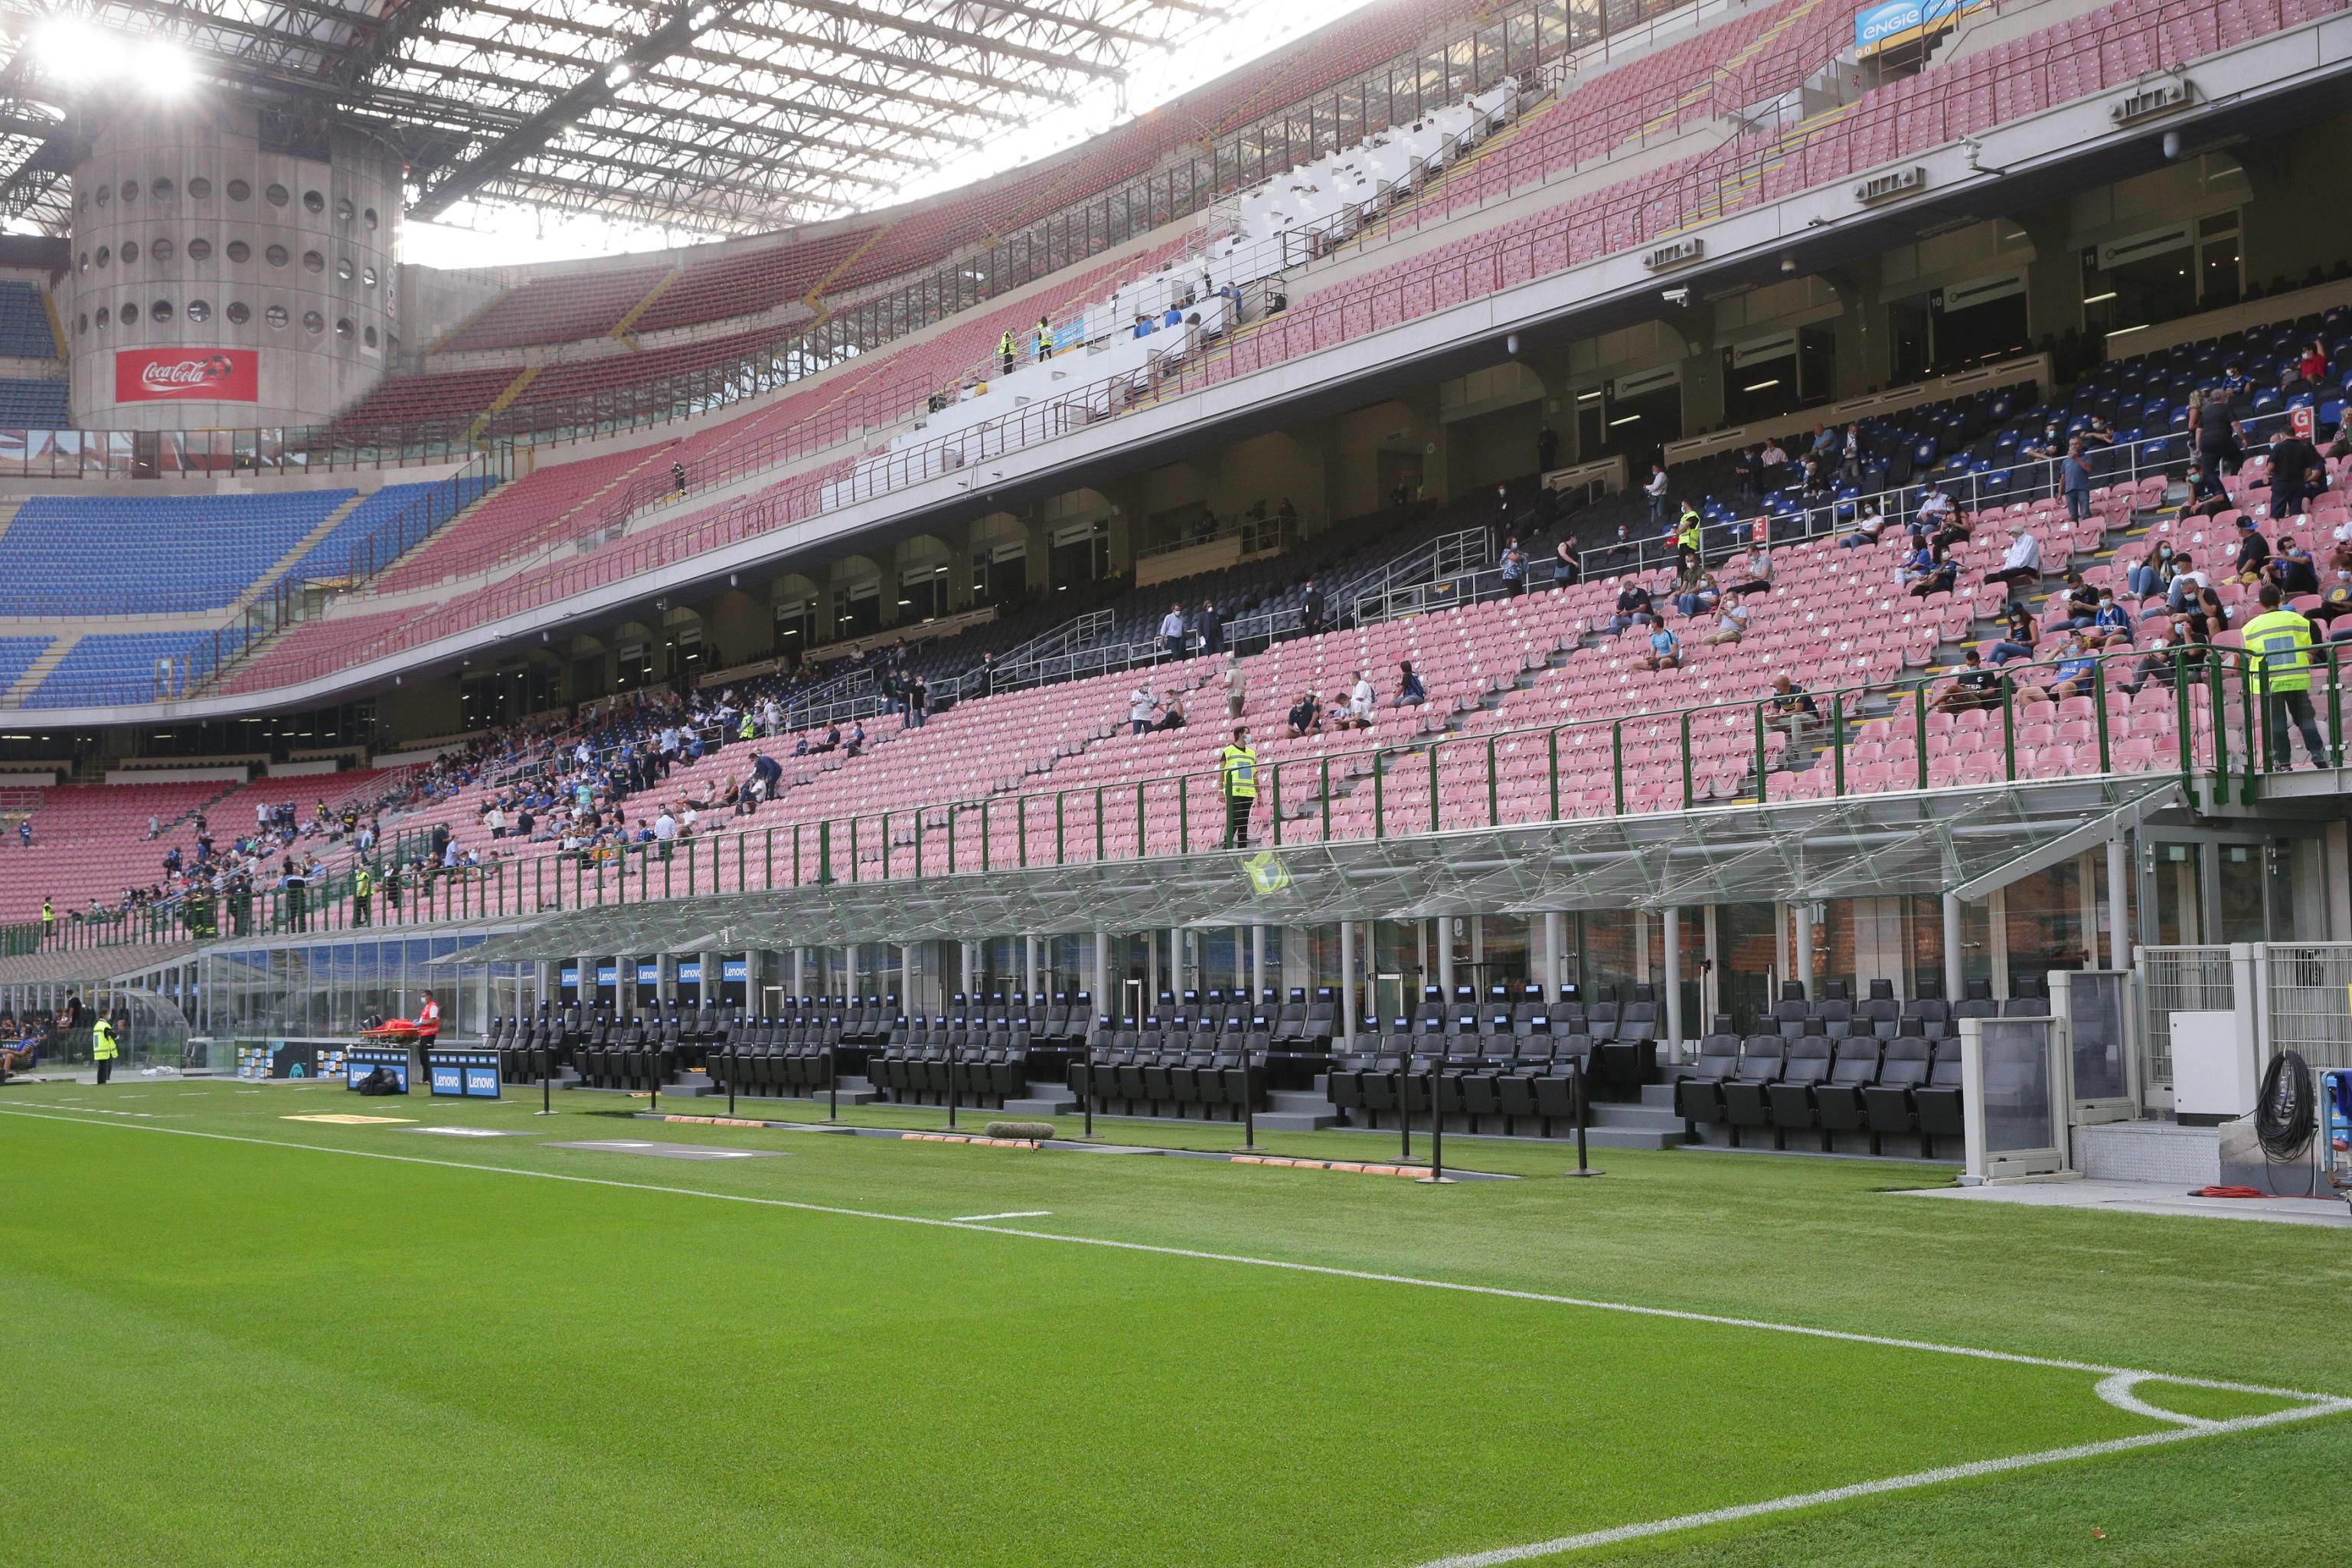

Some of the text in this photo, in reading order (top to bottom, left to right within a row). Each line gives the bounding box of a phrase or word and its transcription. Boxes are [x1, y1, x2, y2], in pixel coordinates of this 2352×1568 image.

[1931, 296, 1942, 308] 10
[142, 361, 208, 383] Coca-Cola
[2295, 410, 2308, 427] G
[562, 973, 578, 982] Lenov
[639, 969, 658, 980] Lenov
[434, 1073, 459, 1087] Lenovo
[469, 1076, 495, 1089] Lenovo
